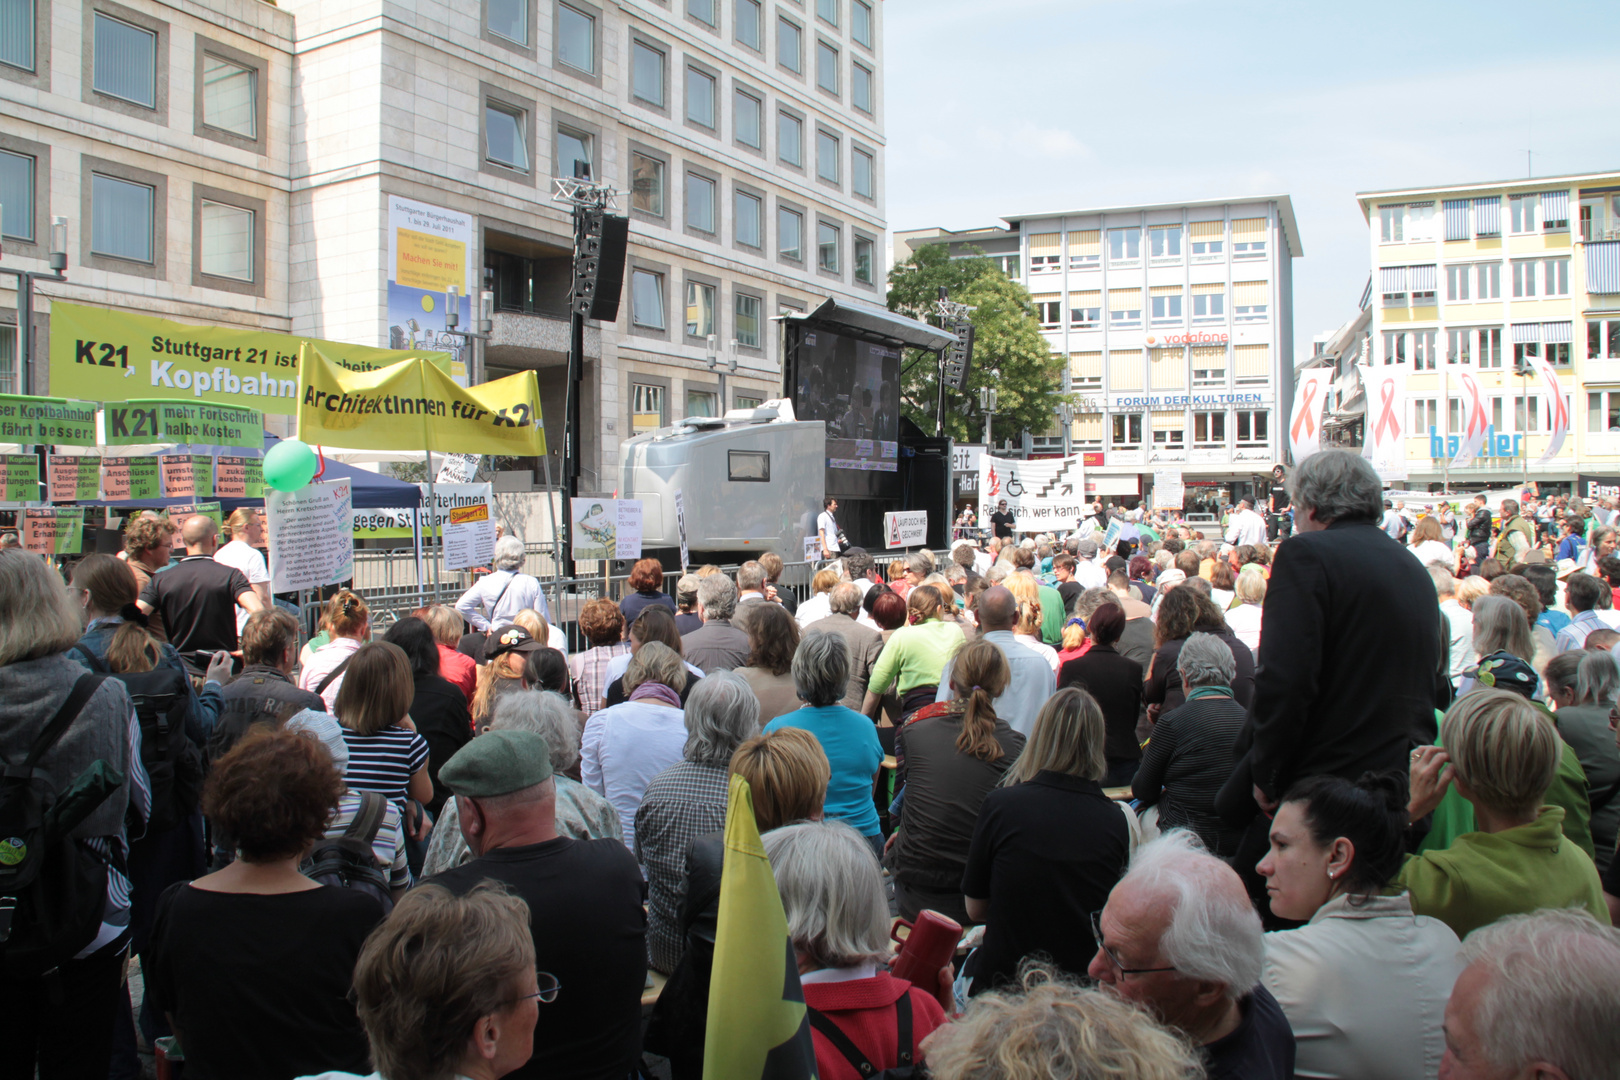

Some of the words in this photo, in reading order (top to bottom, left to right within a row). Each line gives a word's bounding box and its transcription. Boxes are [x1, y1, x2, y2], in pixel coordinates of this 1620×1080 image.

[395, 203, 426, 217] Stuttgarter
[426, 211, 466, 227] Bürgerhaushalt
[413, 218, 422, 226] bis
[422, 220, 431, 228] 29.
[432, 223, 441, 231] Juli
[442, 225, 455, 234] 2011
[402, 252, 430, 265] Machen
[432, 258, 443, 268] Sie
[444, 262, 458, 271] mit!
[1164, 331, 1229, 344] vodafone
[75, 339, 129, 369] K21
[151, 335, 242, 363] Stuttgart
[245, 348, 268, 364] 21
[274, 351, 298, 368] ist
[151, 359, 300, 398] Kopfbahn
[304, 385, 446, 418] ArchitektInnen
[451, 400, 488, 420] für
[1117, 396, 1160, 406] FORUM
[1164, 395, 1189, 405] DER
[1193, 393, 1262, 404] KULTUREN
[20, 404, 96, 422] Kopfbahnhof
[164, 406, 195, 419] mehr
[199, 407, 259, 425] Fortschritt
[111, 408, 158, 437] K21
[2, 422, 33, 437] fährt
[39, 423, 94, 440] besser:
[165, 422, 199, 436] halbe
[202, 423, 242, 439] Kosten
[106, 468, 155, 477] Anschlüsse
[115, 478, 147, 486] besser:
[166, 485, 195, 493] kaum!
[15, 489, 26, 498] ja!
[104, 488, 130, 496] kaum!
[139, 487, 150, 496] ja!
[333, 485, 349, 500] K21
[296, 504, 334, 512] Kretschmann:
[478, 508, 486, 516] 21
[1009, 506, 1031, 519] sich,
[1032, 509, 1051, 518] wer
[1054, 505, 1080, 517] kann
[353, 514, 396, 532] gegen
[27, 541, 48, 549] nein!
